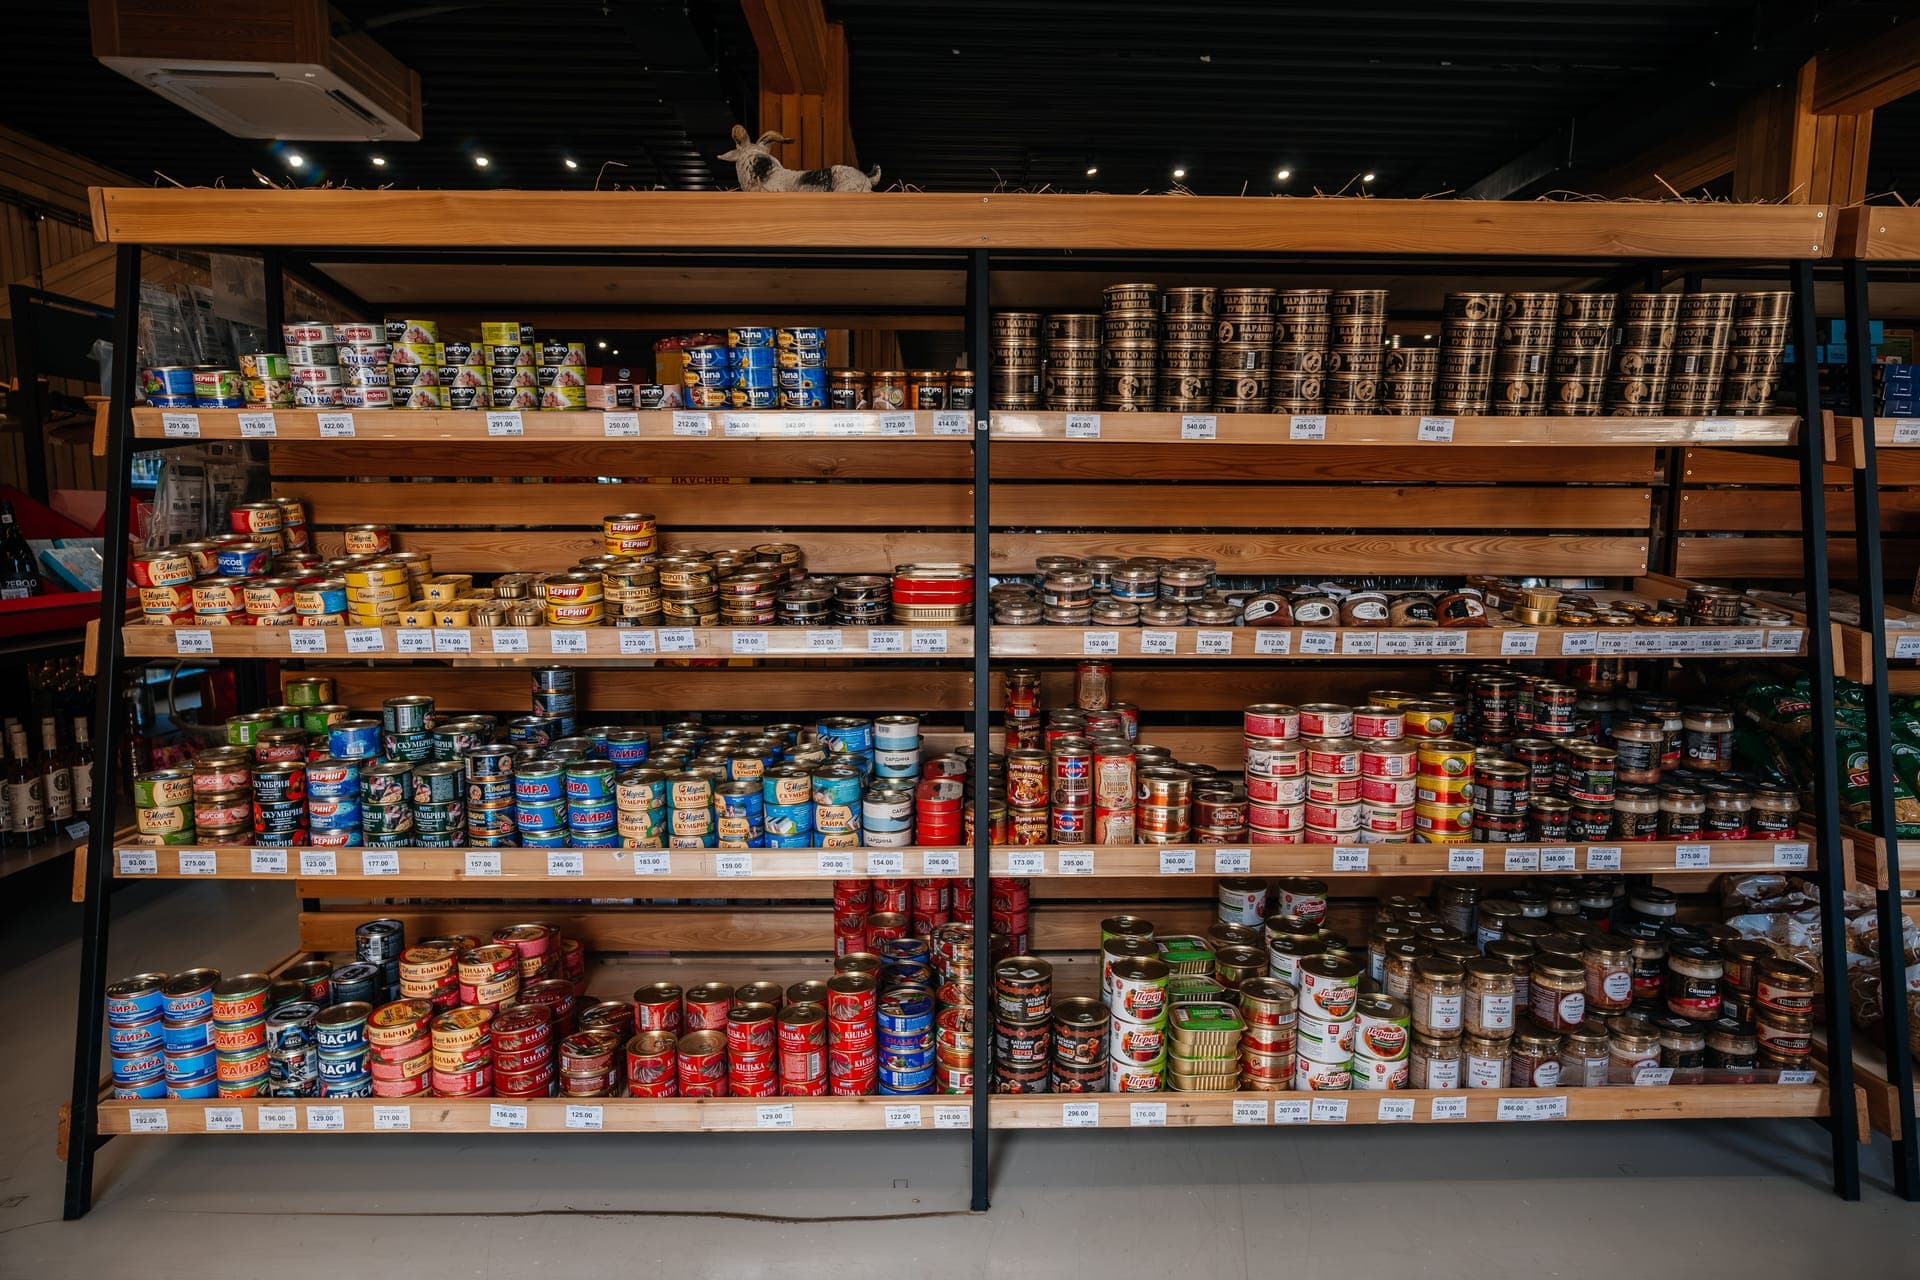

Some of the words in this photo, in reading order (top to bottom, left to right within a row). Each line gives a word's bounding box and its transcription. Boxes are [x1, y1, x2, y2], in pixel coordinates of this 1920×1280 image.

[739, 330, 762, 338] Tuna
[795, 330, 816, 339] Tuna
[347, 356, 374, 364] TUNA
[691, 351, 712, 360] Tuna
[800, 351, 820, 360] Tuna
[700, 370, 720, 379] Tuna
[748, 390, 768, 398] Tuna
[788, 390, 808, 398] Tuna
[304, 396, 332, 404] TUNA
[612, 523, 640, 532] БЕРИНГ
[622, 540, 649, 548] БЕРИНГ
[550, 587, 579, 596] БЕРИНГ
[558, 608, 589, 616] БЕРИНГ
[311, 772, 344, 781] БЕРИНГ
[166, 790, 190, 799] САЛАТ
[262, 808, 303, 818] СКУМБРИЯ
[313, 836, 345, 844] БЕРИНГ
[446, 1032, 480, 1044] КИЛЬКА
[844, 1030, 872, 1039] КИЛЬКА
[736, 1062, 765, 1071] КИЛЬКА
